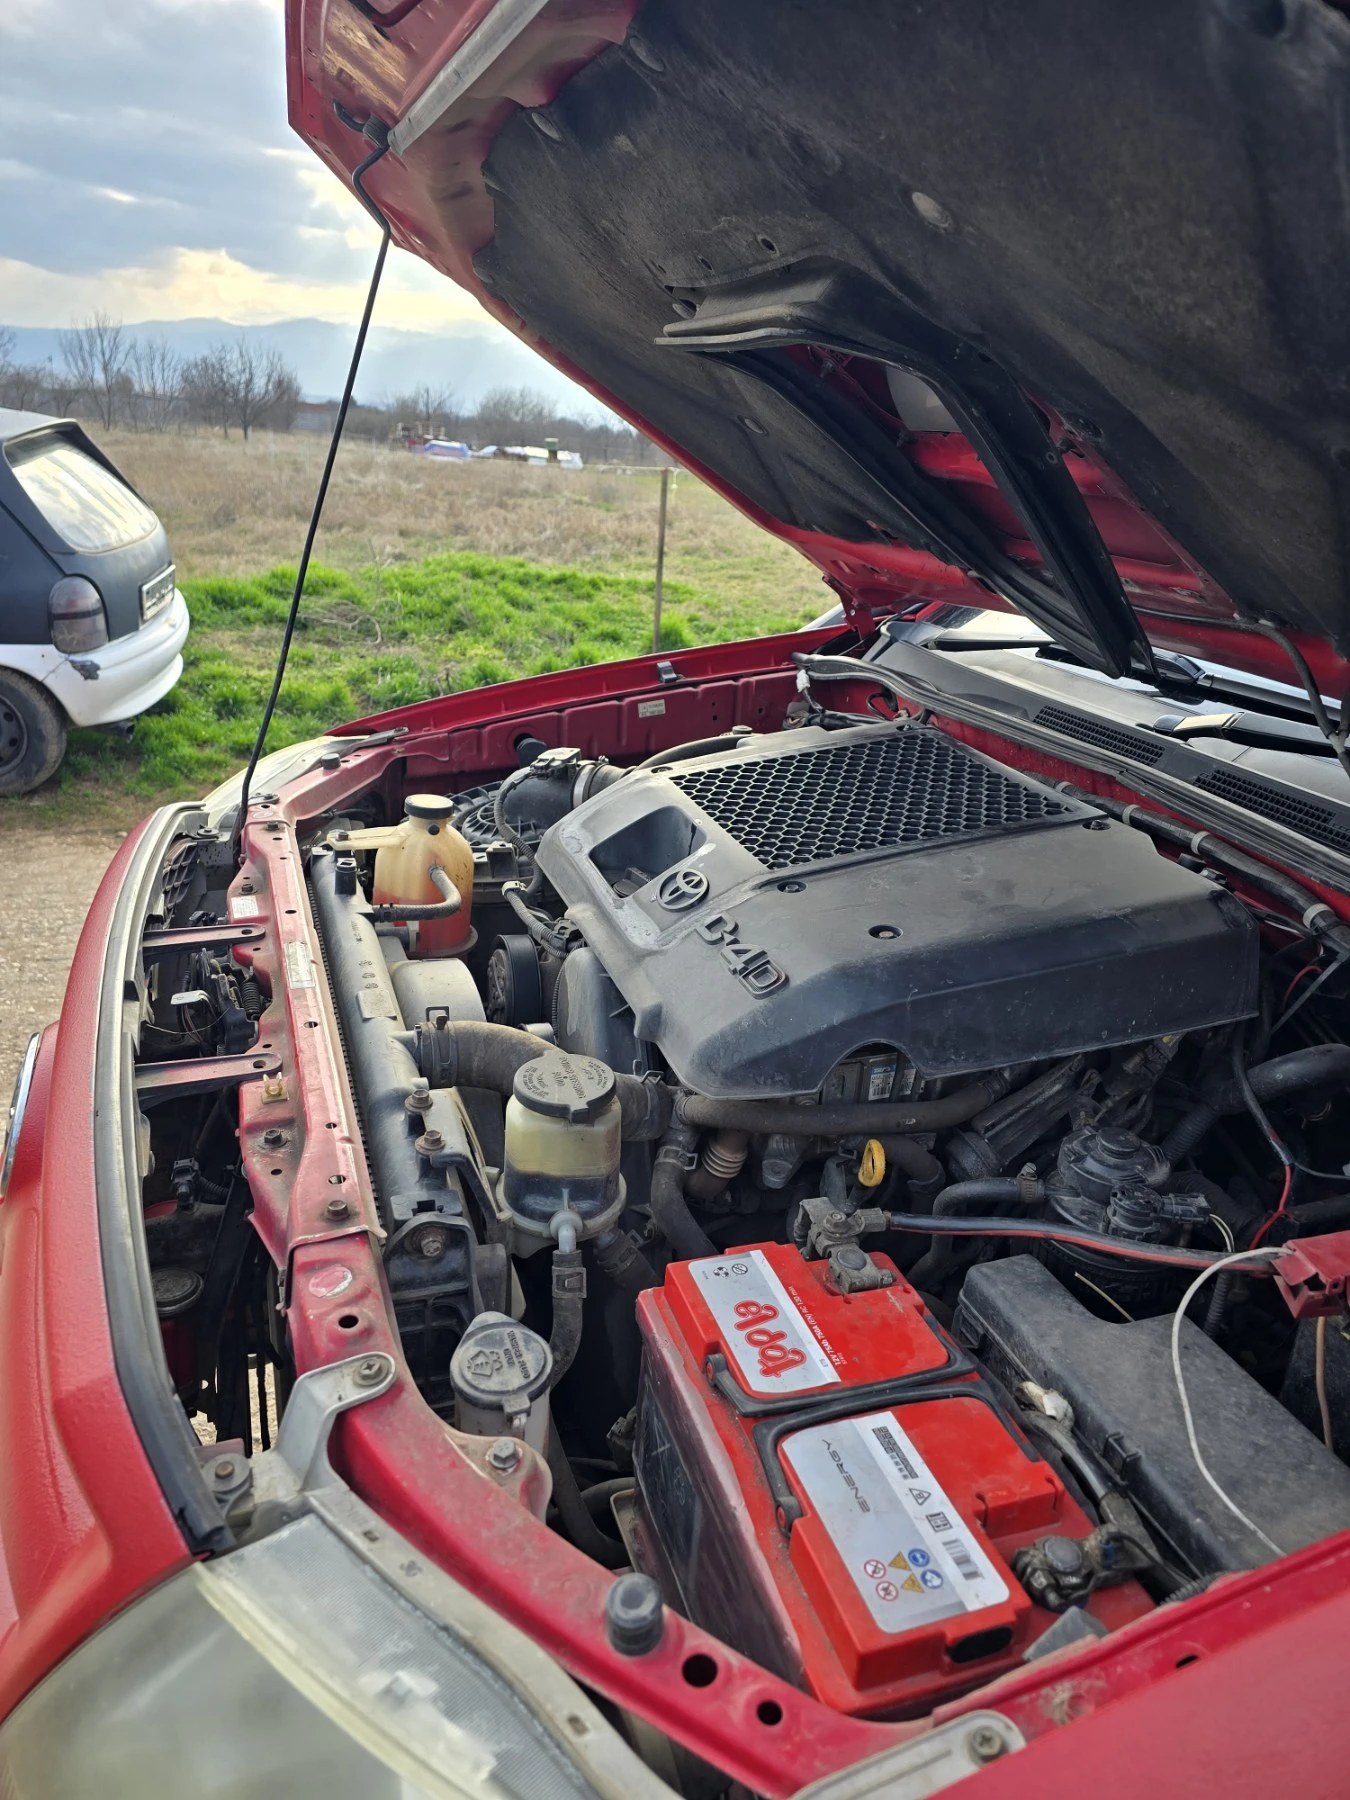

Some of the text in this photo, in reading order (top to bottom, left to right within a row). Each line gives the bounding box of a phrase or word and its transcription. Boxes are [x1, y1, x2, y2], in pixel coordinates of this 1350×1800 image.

[805, 1313, 817, 1325] (EN)
[734, 1300, 807, 1378] topla
[812, 1325, 825, 1339] 750A
[821, 1339, 834, 1354] 75Ah
[830, 1354, 842, 1366] 12V
[822, 1439, 870, 1513] ENERGY
